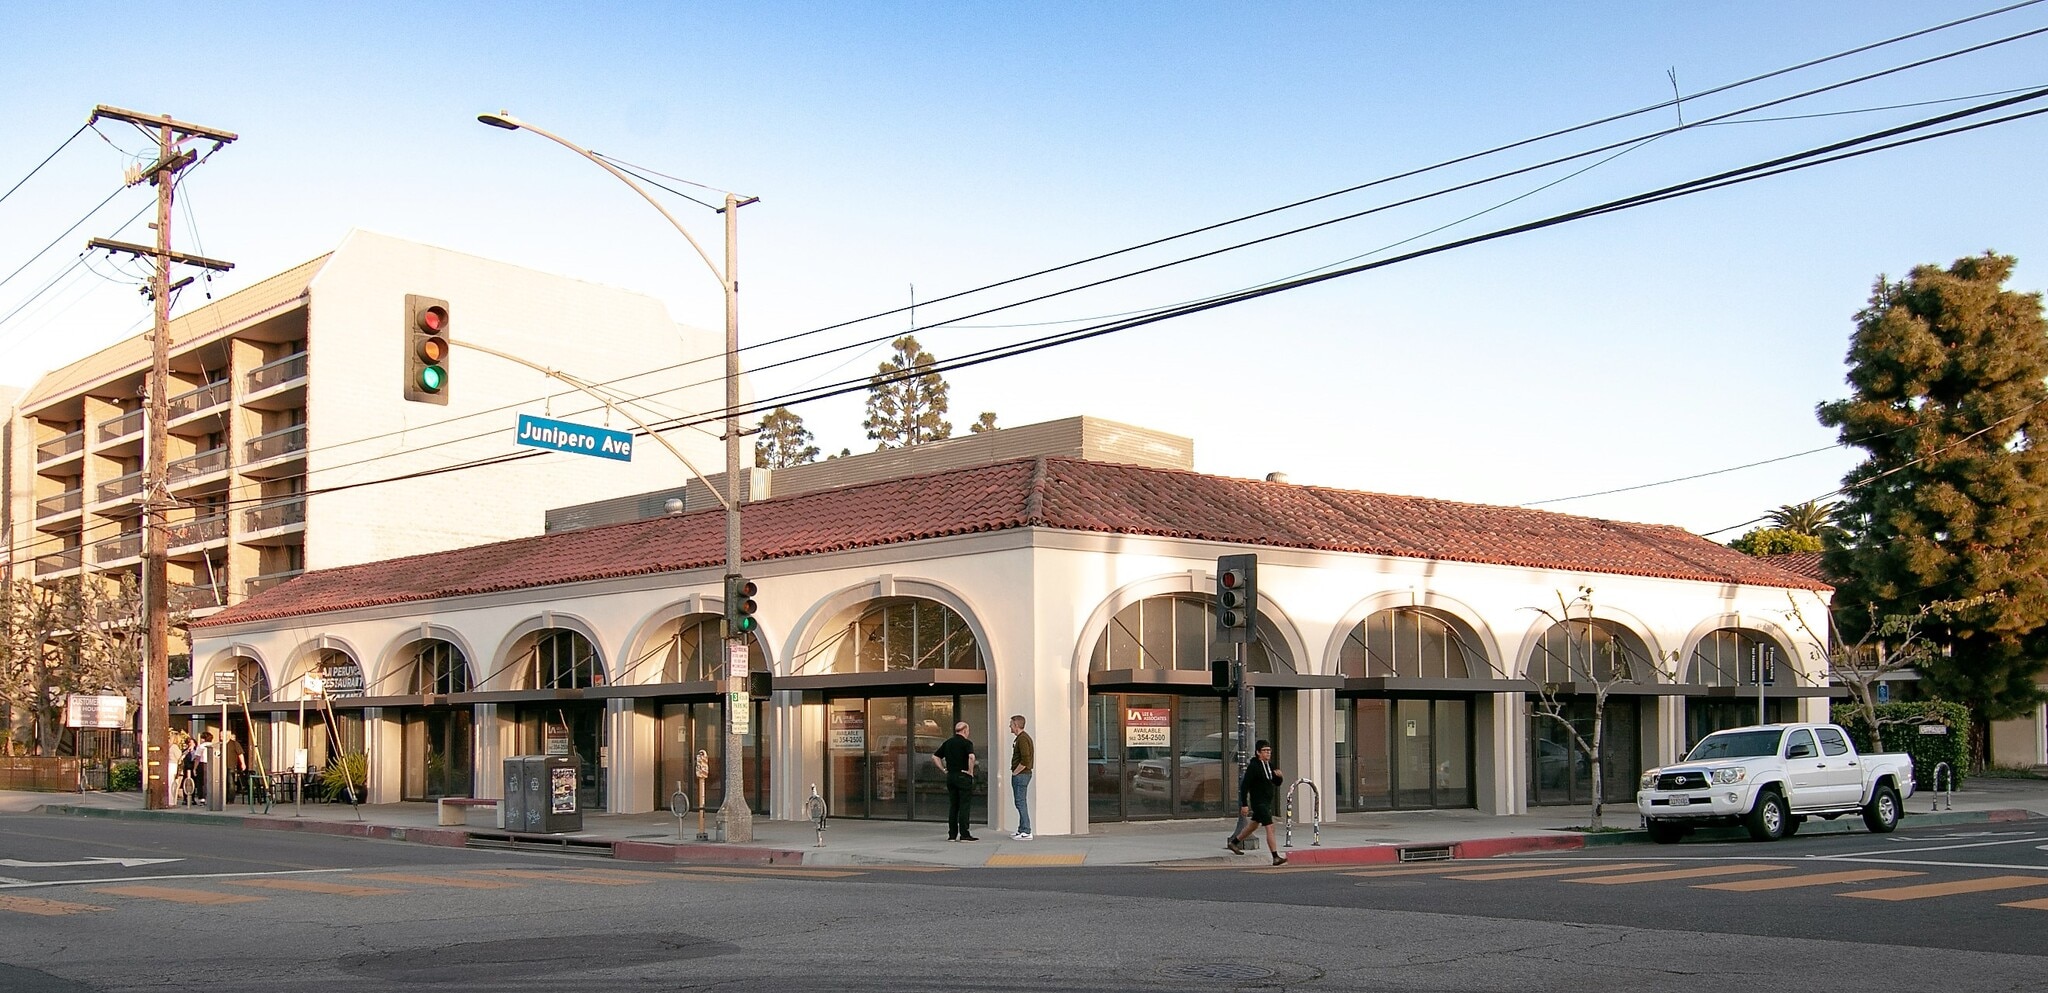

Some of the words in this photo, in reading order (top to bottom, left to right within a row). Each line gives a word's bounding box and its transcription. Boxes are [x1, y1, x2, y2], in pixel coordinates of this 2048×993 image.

[520, 421, 595, 449] Junipero
[601, 435, 631, 455] Ave
[733, 692, 739, 701] 3
[1137, 733, 1166, 741] 354-2500
